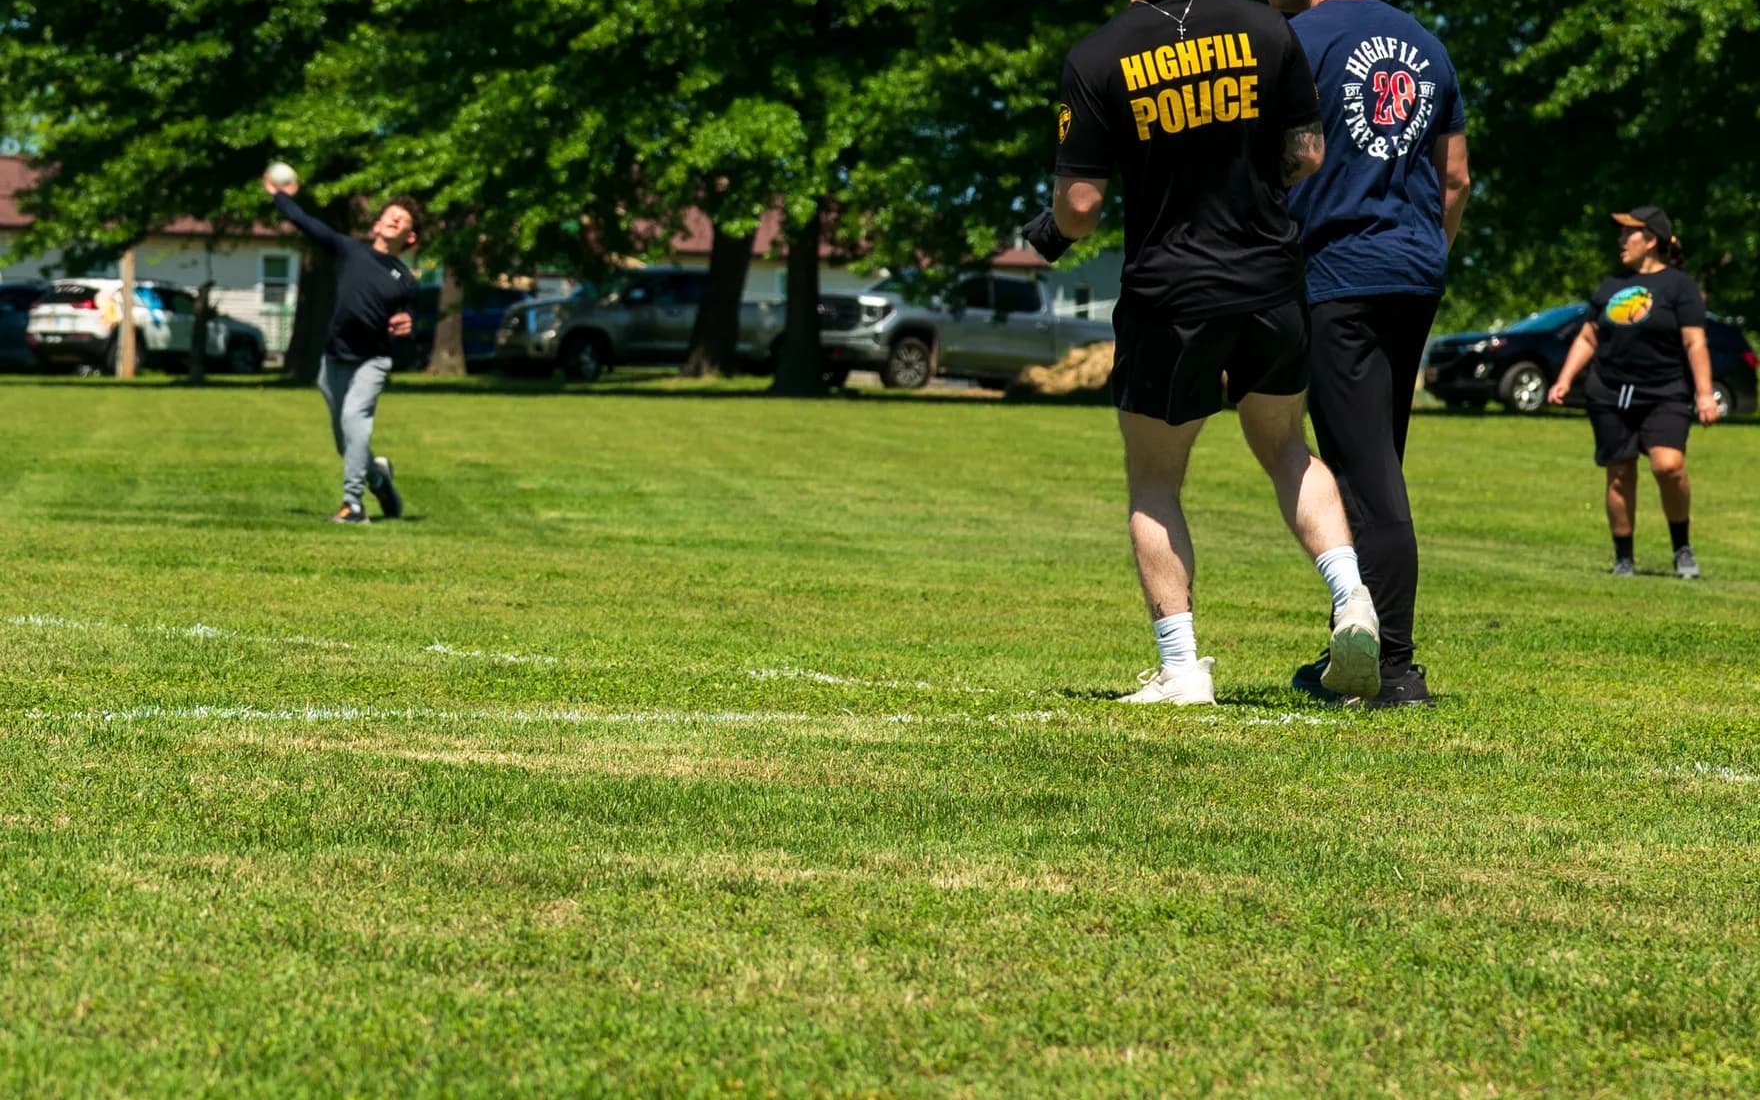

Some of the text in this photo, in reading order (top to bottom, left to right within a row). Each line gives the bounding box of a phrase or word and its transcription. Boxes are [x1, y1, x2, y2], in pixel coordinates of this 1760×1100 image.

[1120, 32, 1258, 92] HIGHFILL
[1129, 74, 1260, 141] POLICE
[1372, 70, 1417, 125] 28
[1344, 100, 1375, 150] FIRE
[1368, 135, 1391, 161] &
